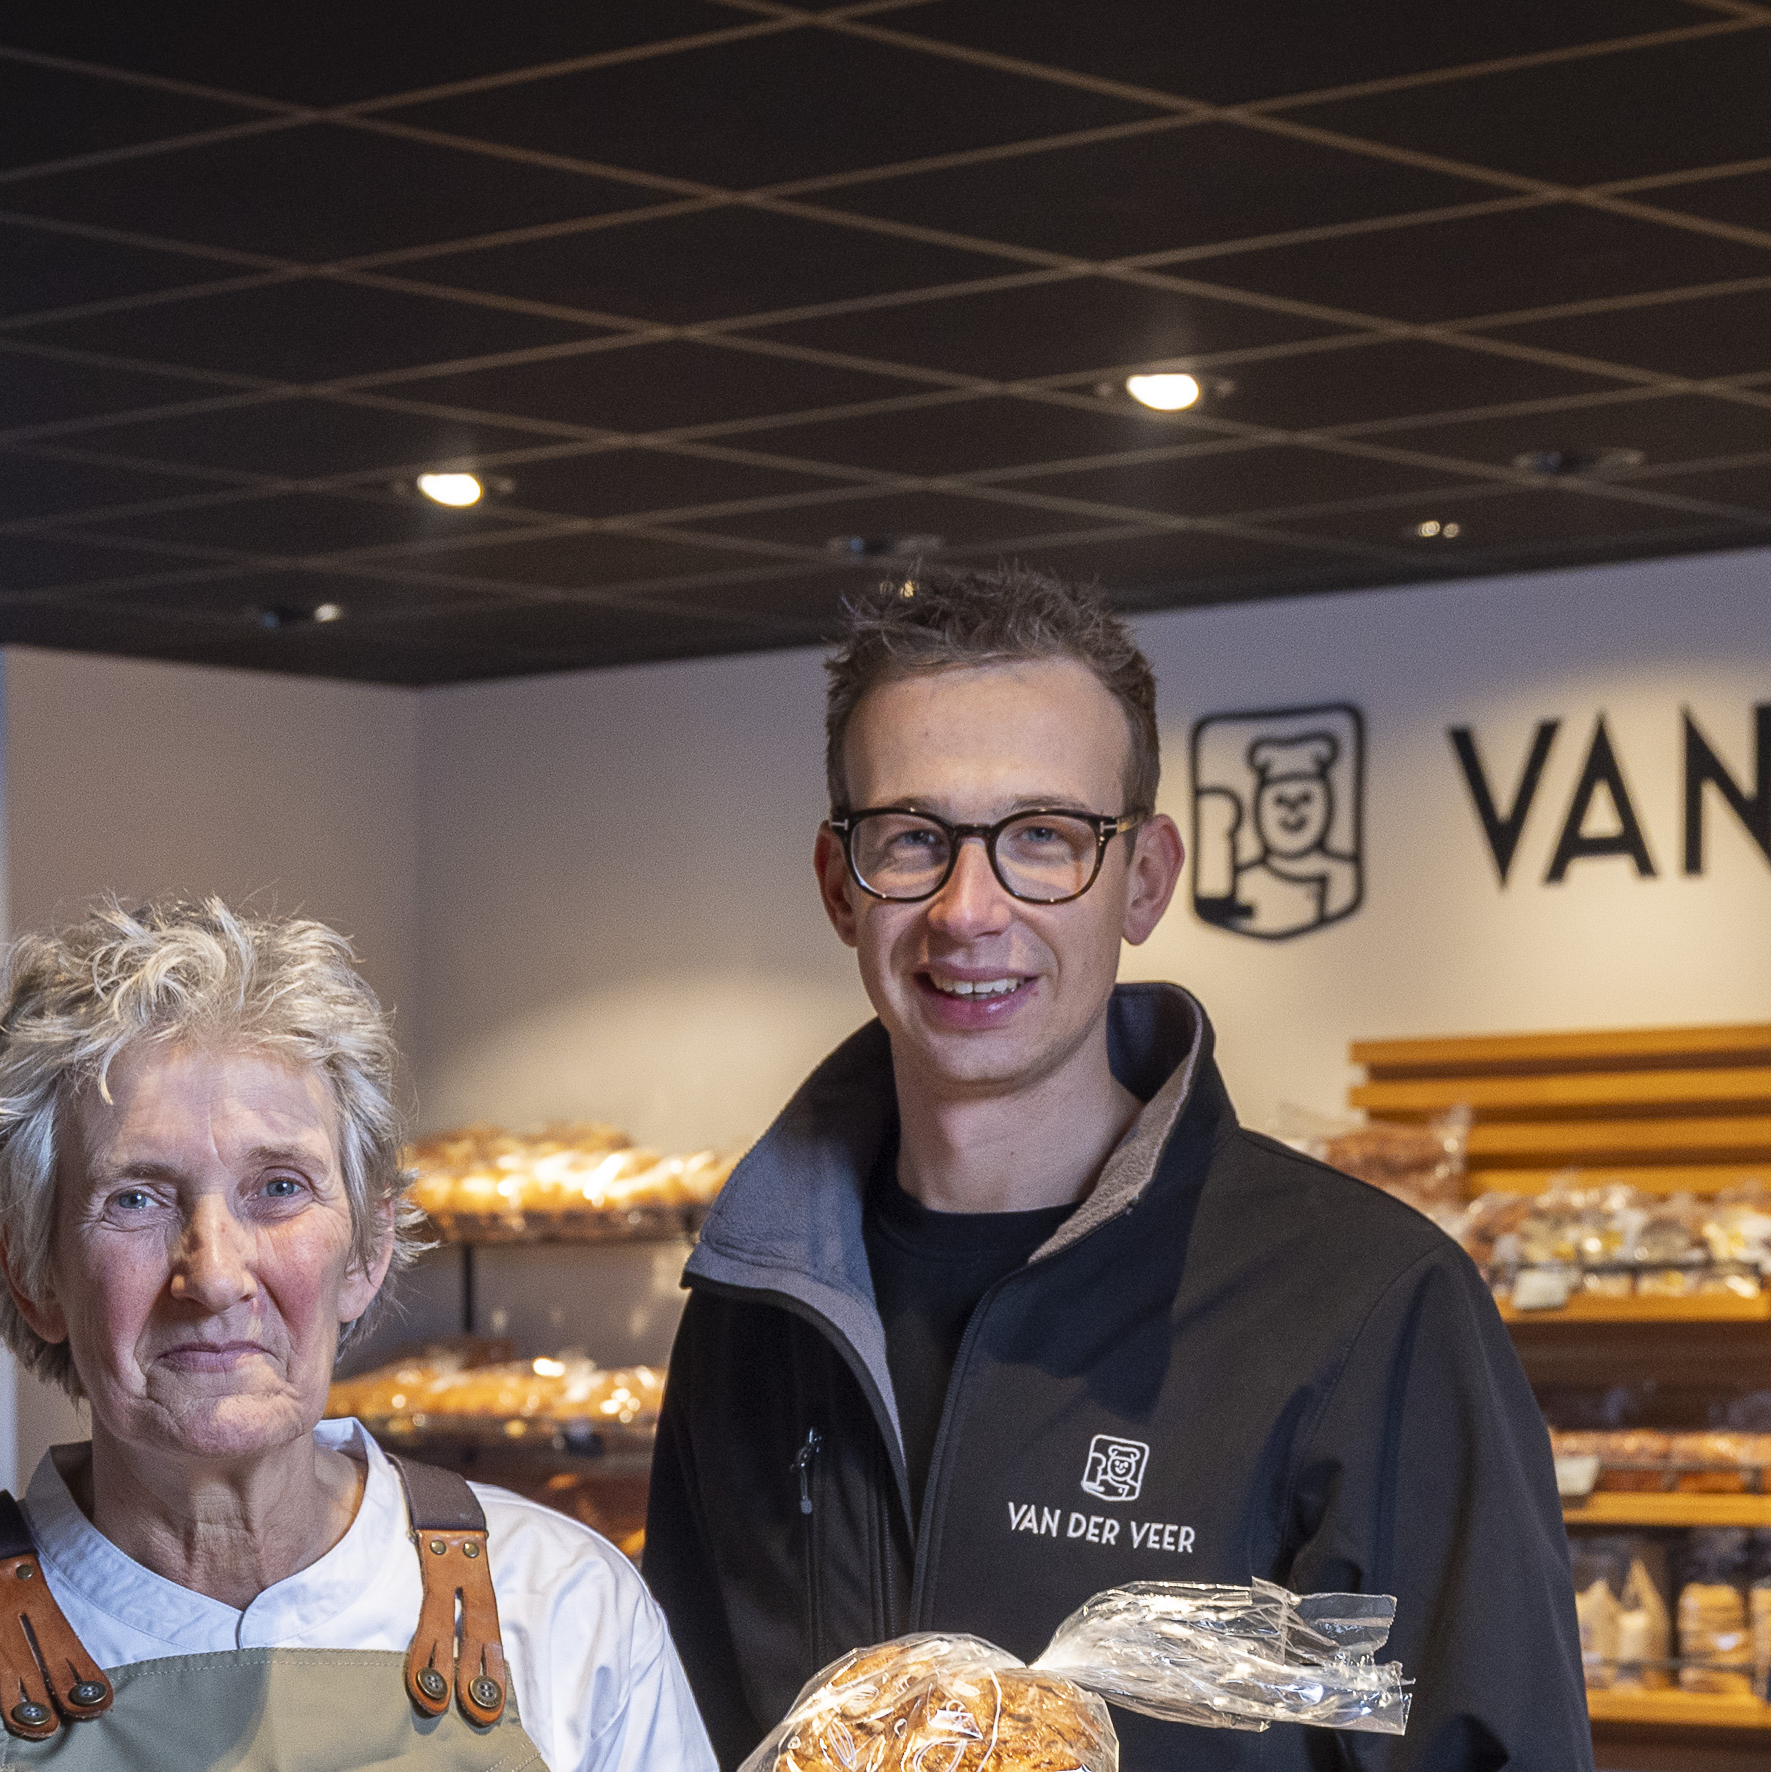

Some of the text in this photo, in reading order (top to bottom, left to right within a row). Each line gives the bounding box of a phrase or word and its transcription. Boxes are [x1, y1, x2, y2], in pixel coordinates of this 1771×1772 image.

[1008, 1502, 1195, 1553] VAN DER VEER
